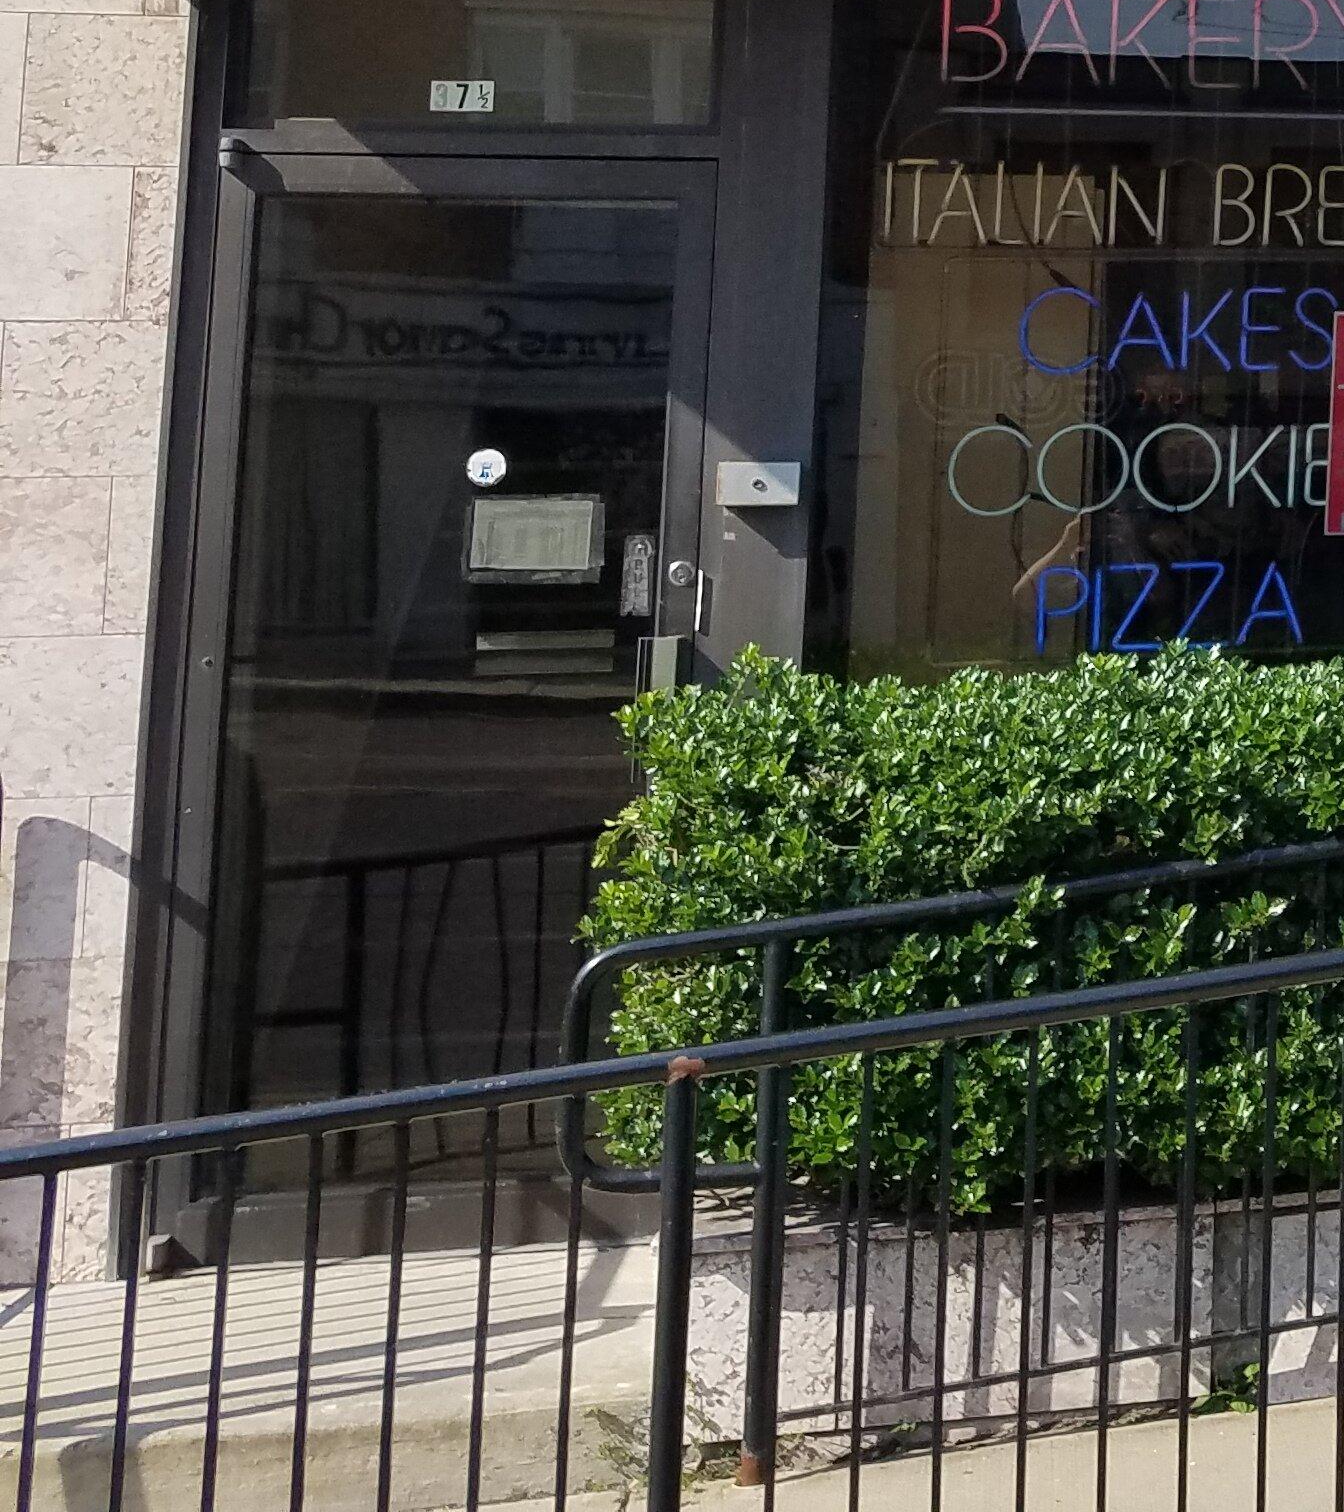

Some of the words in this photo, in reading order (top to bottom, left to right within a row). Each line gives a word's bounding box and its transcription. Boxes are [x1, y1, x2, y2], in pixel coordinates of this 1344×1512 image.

[884, 158, 1168, 247] ITALIAN
[1018, 286, 1339, 376] CAKES
[947, 422, 1328, 517] COOKIE
[1035, 561, 1304, 655] PIZZA
